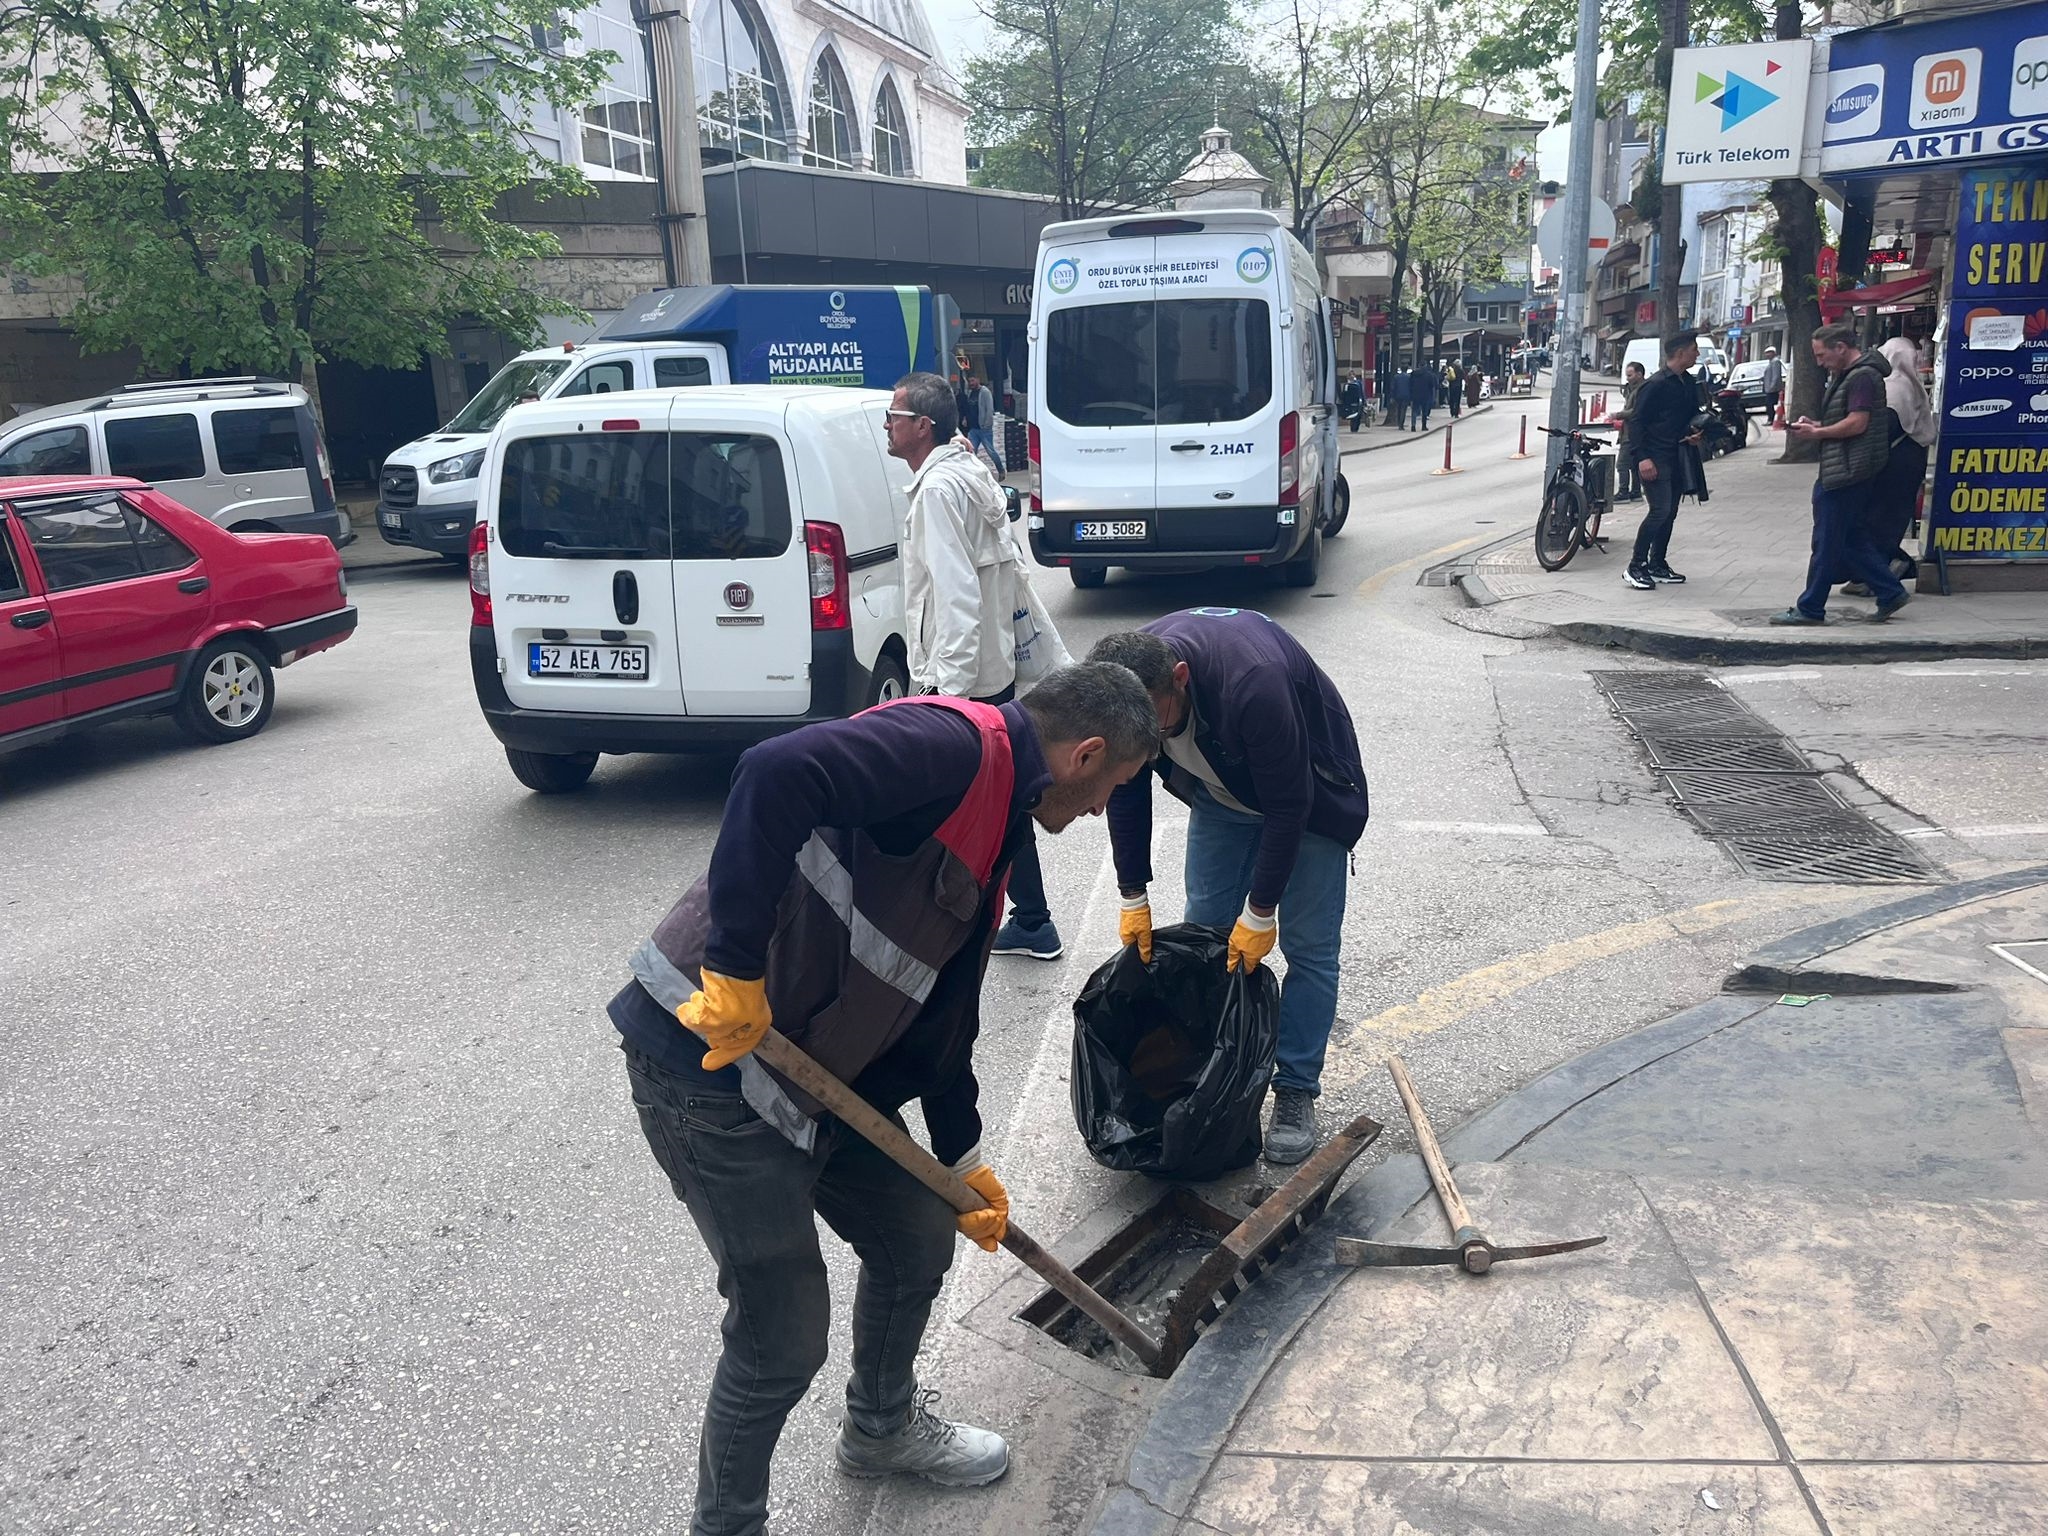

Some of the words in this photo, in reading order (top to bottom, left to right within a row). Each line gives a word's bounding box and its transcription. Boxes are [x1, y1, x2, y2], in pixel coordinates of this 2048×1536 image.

[1831, 95, 1873, 113] SAMSUNG
[1920, 106, 1965, 122] xiaomi
[1887, 131, 1983, 163] ARTI
[1998, 123, 2048, 150] GS
[1676, 151, 1712, 165] Türk
[1718, 147, 1790, 163] Telekom
[1974, 181, 2048, 223] TEKN
[1088, 268, 1111, 277] ORDU
[1112, 265, 1141, 275] BÜYÜK
[1144, 262, 1168, 275] ŞEHİR
[1170, 259, 1219, 271] BELEDİYESİ
[1242, 262, 1266, 271] 0107
[1967, 242, 2046, 286] SERV
[1098, 279, 1119, 289] ÖZEL
[1121, 278, 1147, 287] TOPLU
[1150, 276, 1180, 287] TAŞIMA
[1182, 275, 1208, 284] ARACI
[769, 342, 827, 356] ALTYAPI
[769, 356, 864, 374] MÜDAHALE
[1960, 367, 2014, 379] oppo
[1210, 443, 1254, 455] 2.HAT
[1950, 449, 2048, 473] FATURA
[1950, 482, 2047, 512] ÖDEME
[1082, 524, 1096, 535] 52
[1100, 524, 1107, 535] D
[1112, 523, 1144, 535] 5082
[730, 589, 747, 603] FIAT
[541, 648, 560, 668] 52
[570, 649, 600, 670] AEA
[610, 649, 642, 670] 765
